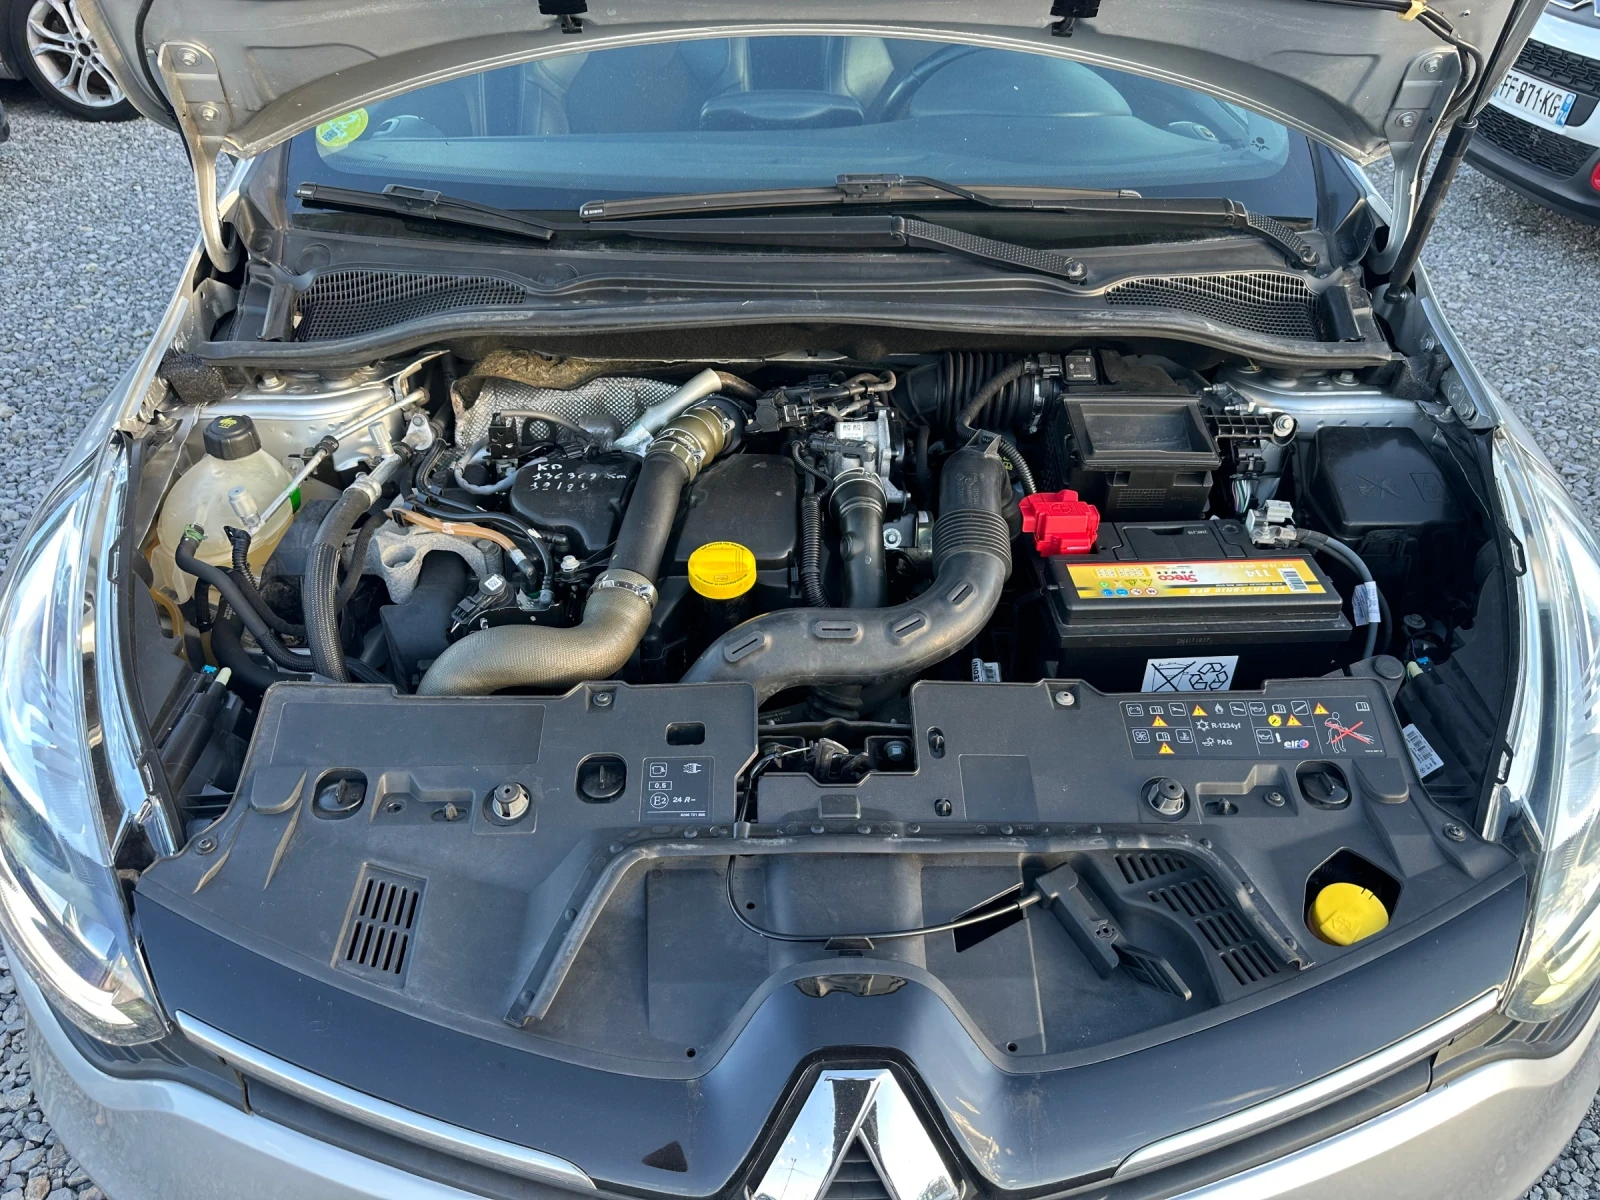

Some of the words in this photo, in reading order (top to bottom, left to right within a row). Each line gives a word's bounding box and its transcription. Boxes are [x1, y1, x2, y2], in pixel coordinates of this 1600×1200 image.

[1211, 722, 1241, 730] R-1234yf
[1283, 740, 1300, 748] elf
[653, 796, 667, 806] E2
